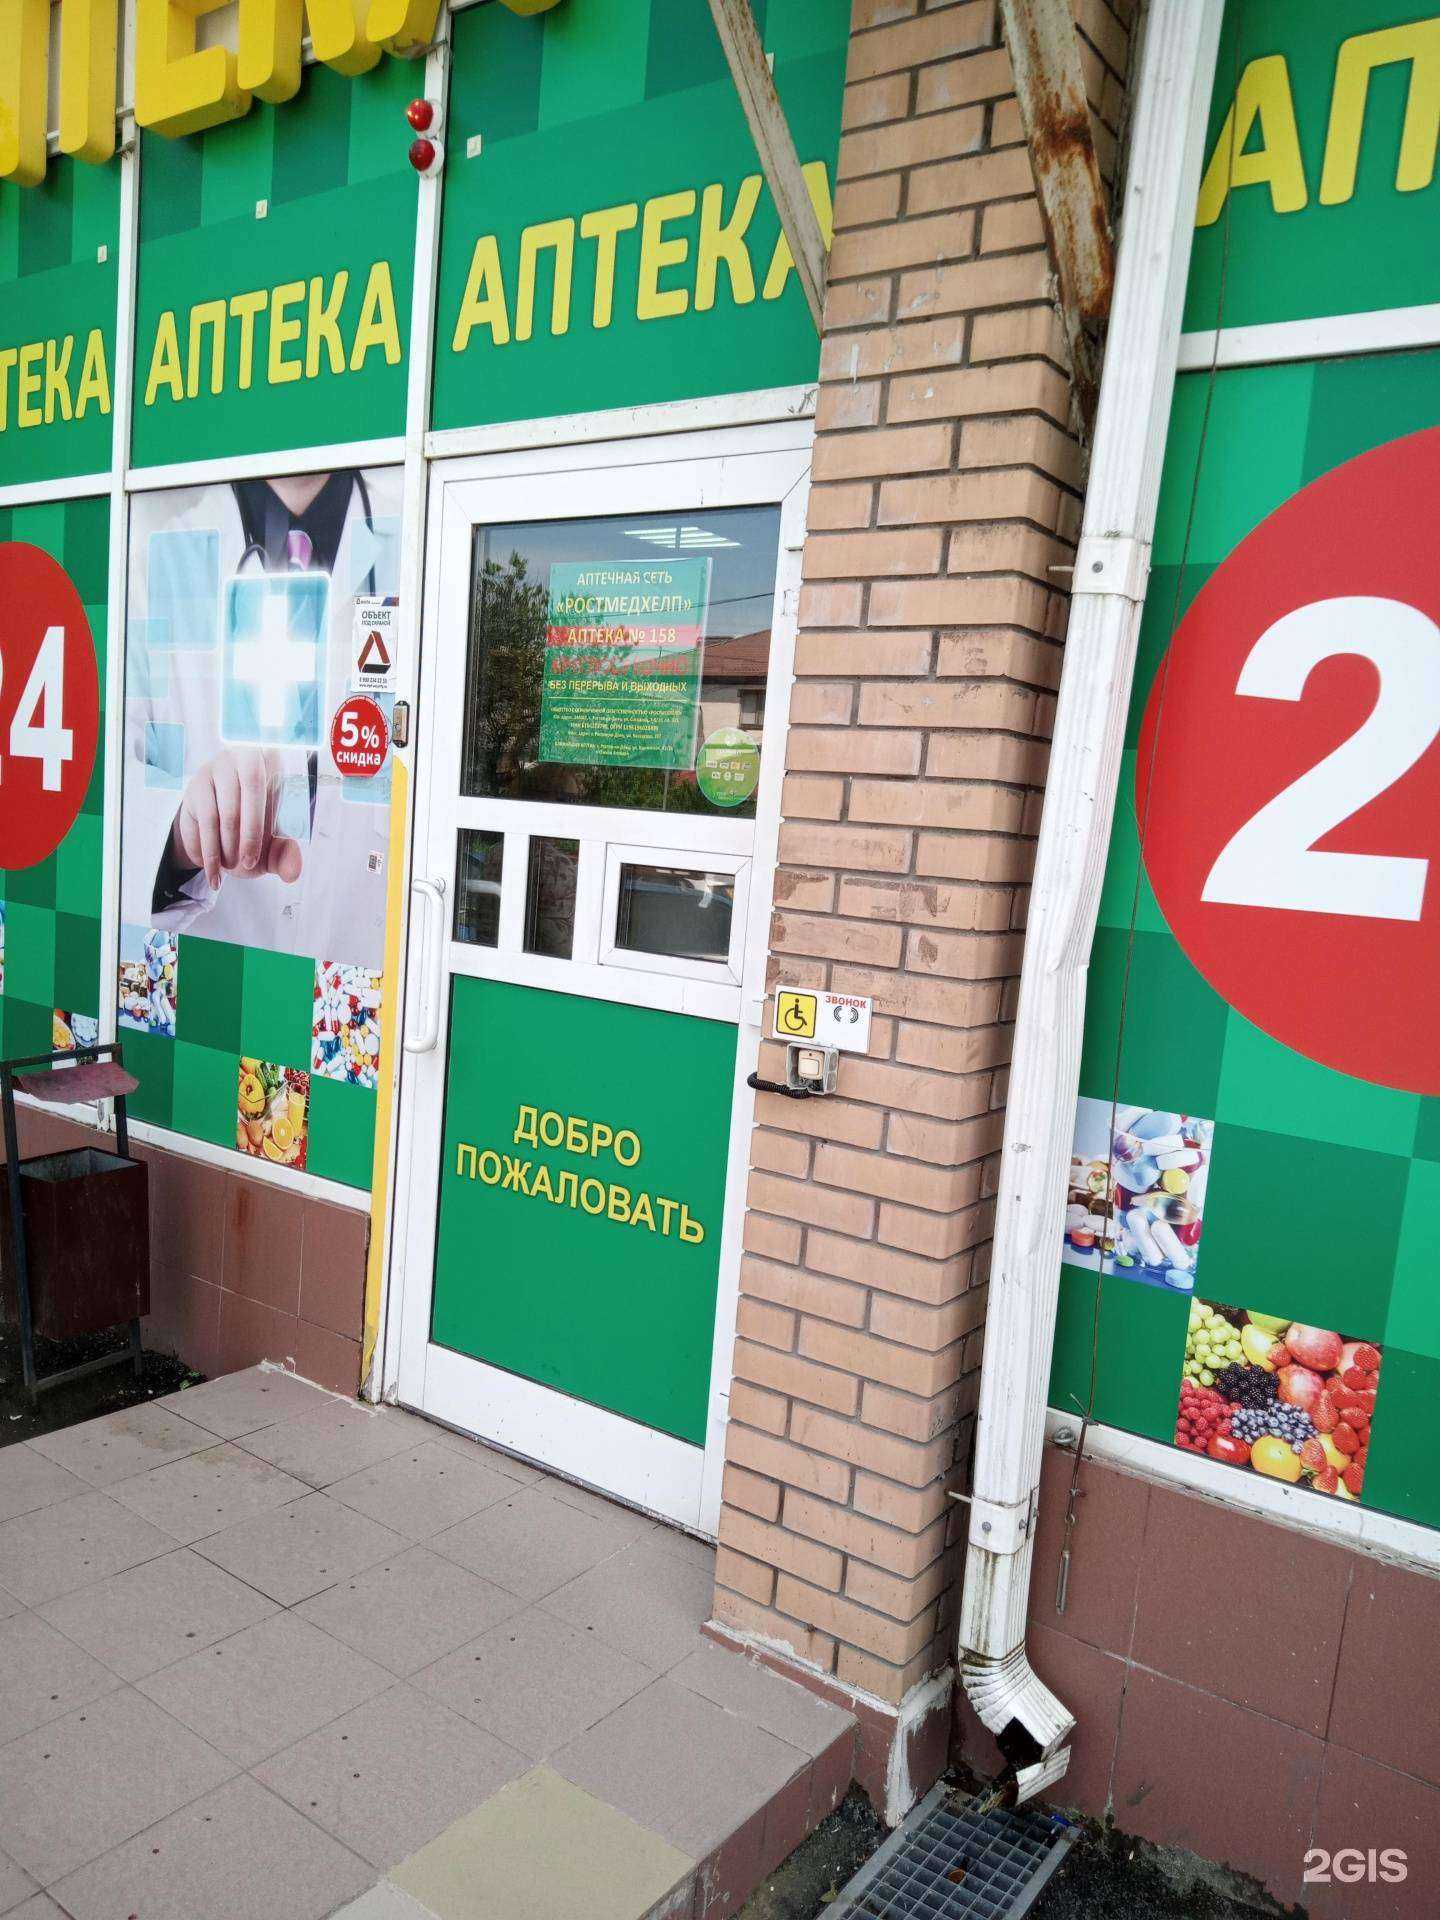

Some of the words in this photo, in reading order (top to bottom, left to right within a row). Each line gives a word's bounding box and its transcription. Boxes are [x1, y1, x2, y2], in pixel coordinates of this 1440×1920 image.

[144, 261, 402, 406] АПТЕКА
[577, 571, 640, 586] АПТЕЧНАЯ
[643, 570, 673, 585] СЕТЬ
[555, 595, 692, 616] «РОСТМЕДХЕЛП»
[361, 610, 392, 620] ОБЪЕКТ
[567, 627, 626, 644] АПТЕКА
[628, 628, 646, 645] №
[649, 627, 677, 644] 158
[549, 679, 567, 690] БЕЗ
[568, 680, 619, 692] ПЕРЕРЫВА
[621, 681, 628, 690] И
[630, 681, 688, 693] ВЫХОДНЫХ
[0, 626, 74, 792] 4
[336, 751, 381, 767] скидка
[825, 995, 867, 1009] ЗВОНОК
[513, 1104, 642, 1168] ДОБРО
[455, 1142, 706, 1245] ПОЖАЛОВАТЬ
